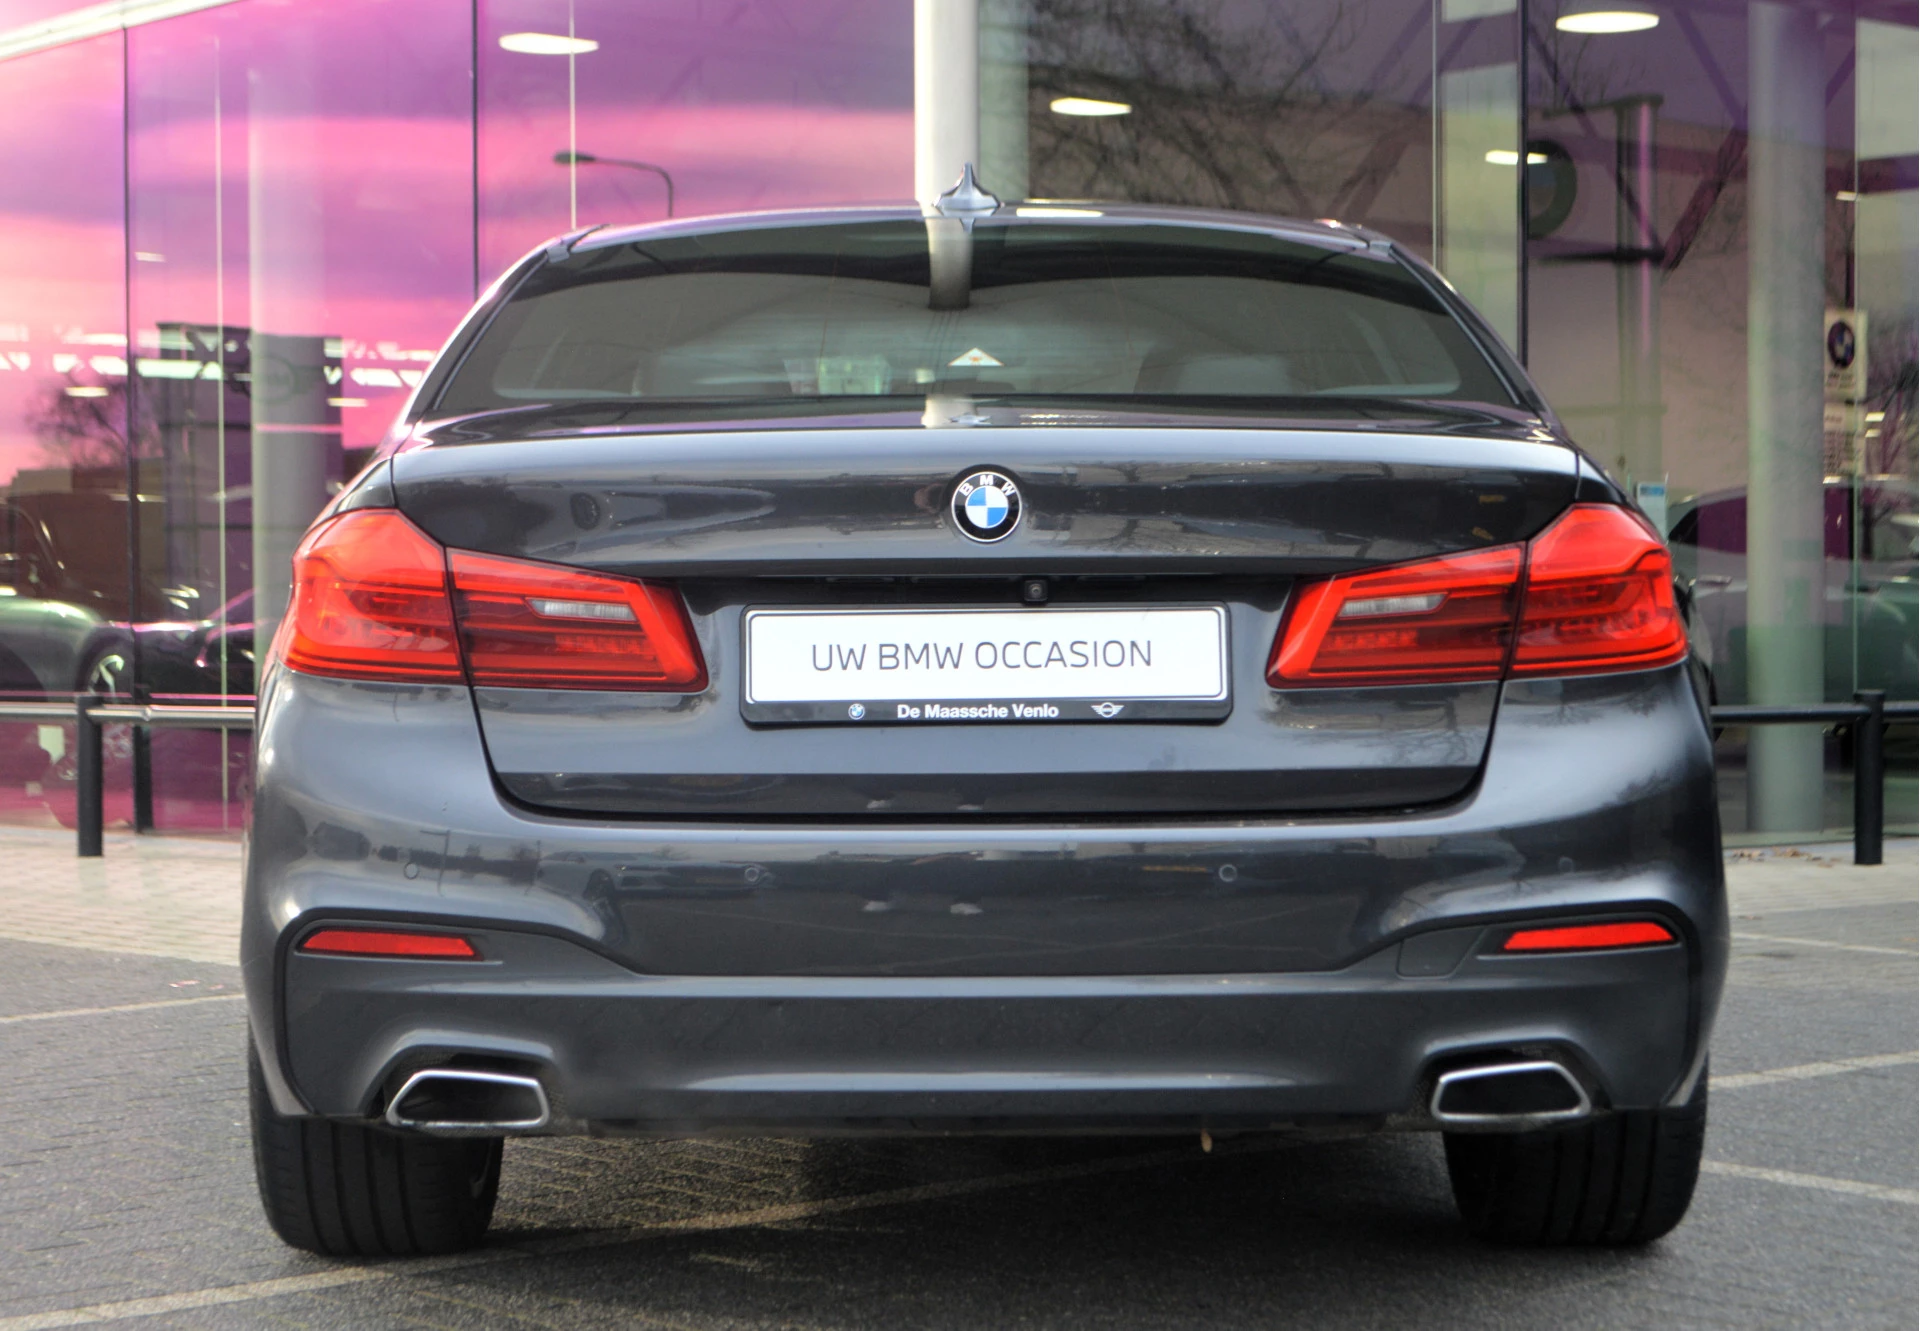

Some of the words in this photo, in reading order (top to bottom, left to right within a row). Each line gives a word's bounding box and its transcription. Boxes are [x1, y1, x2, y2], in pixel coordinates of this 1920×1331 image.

[958, 474, 1016, 497] BMW
[812, 643, 867, 672] UW
[878, 642, 963, 670] BMW
[975, 640, 1151, 669] OCCASION
[897, 704, 920, 719] De
[924, 703, 1009, 719] Maassche
[1011, 703, 1060, 718] Venlo
